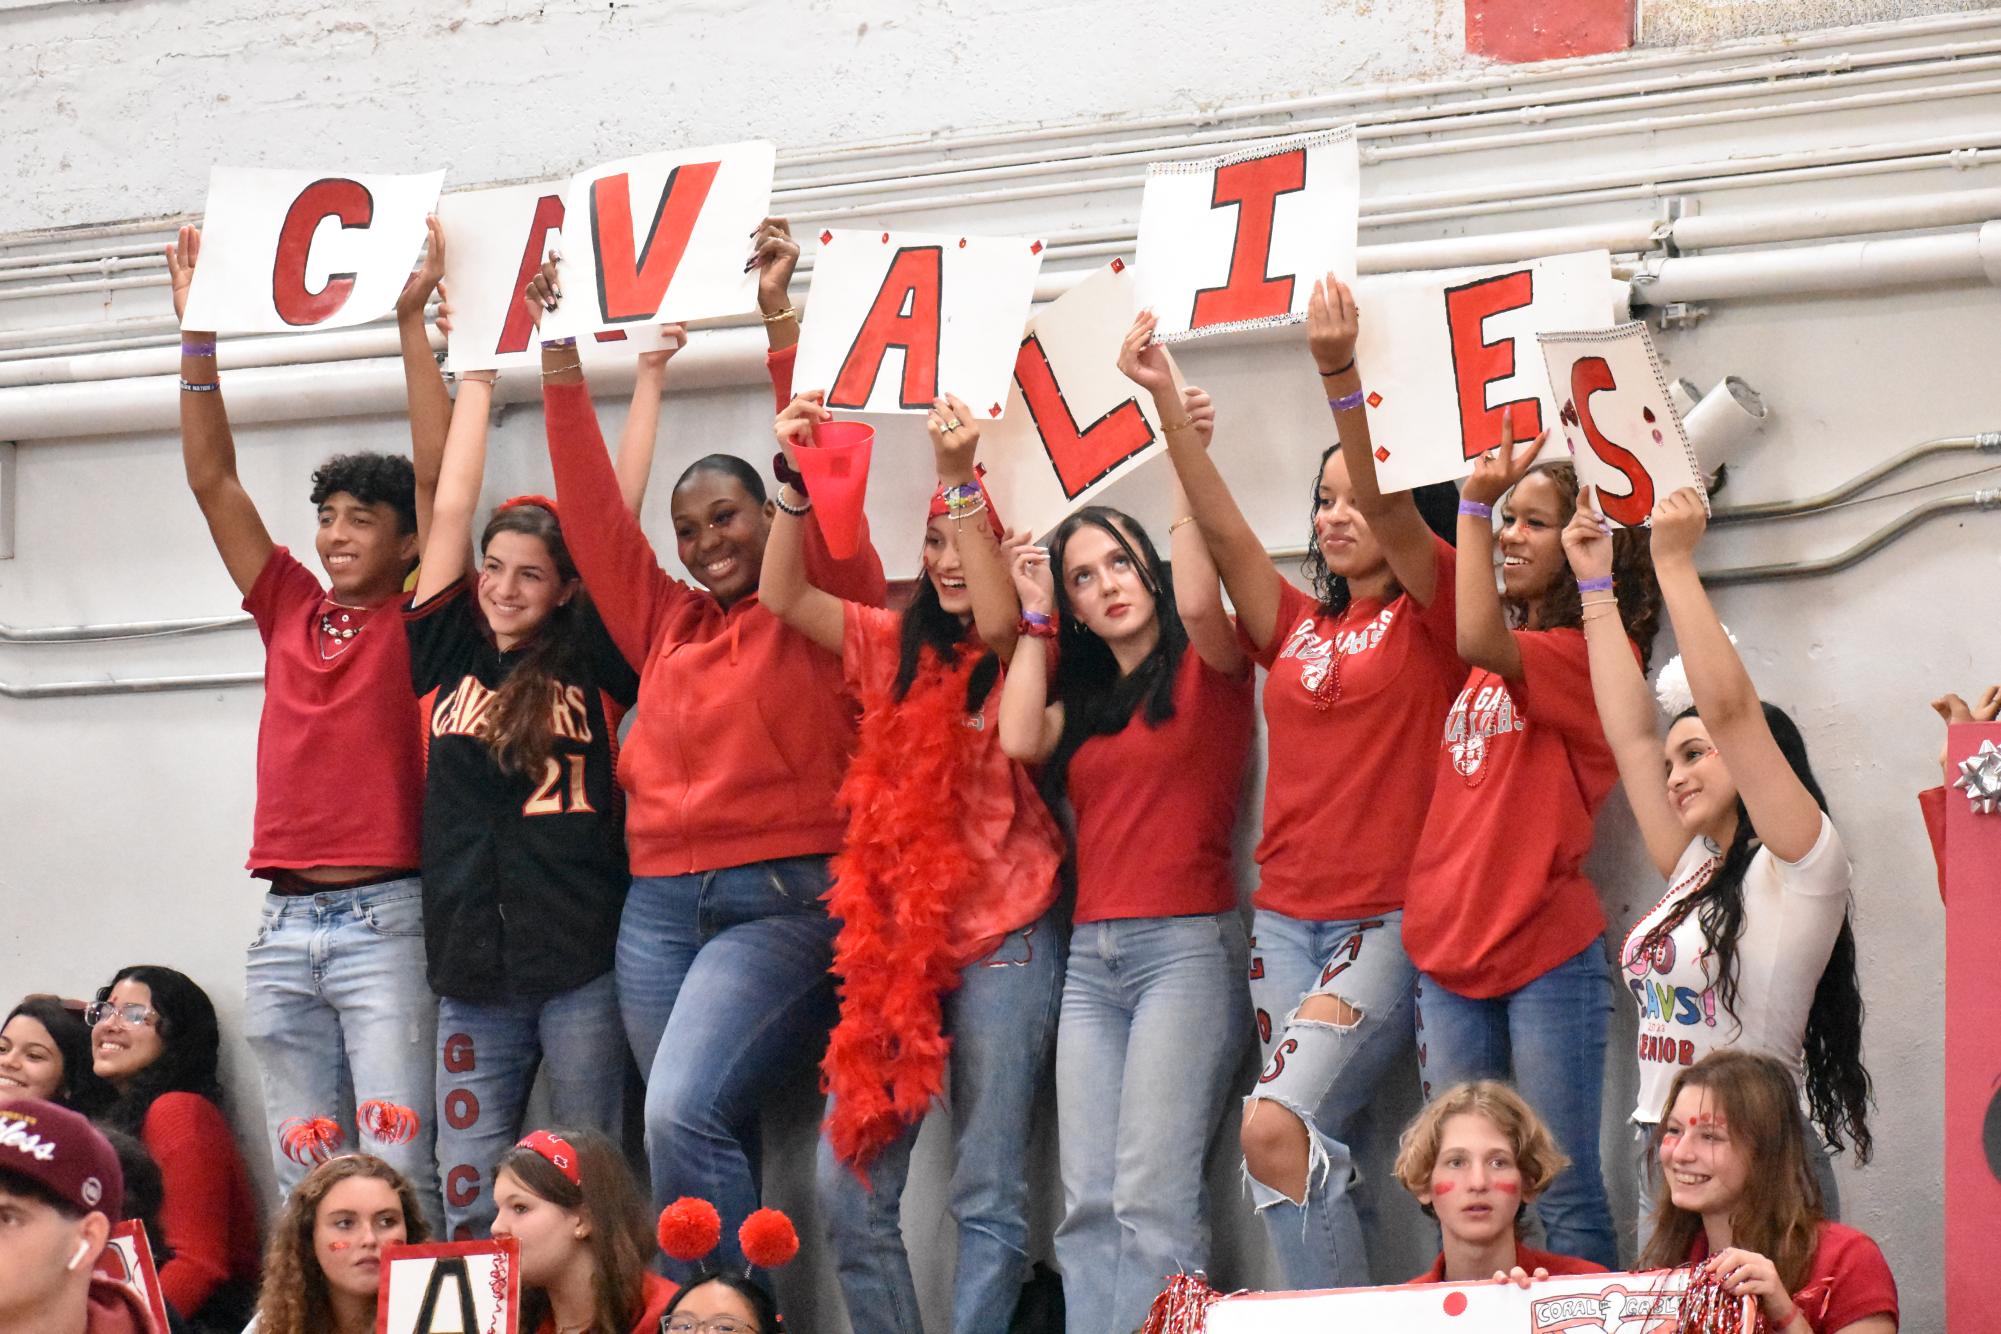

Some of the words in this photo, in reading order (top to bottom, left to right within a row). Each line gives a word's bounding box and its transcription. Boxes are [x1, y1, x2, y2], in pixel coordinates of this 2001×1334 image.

[273, 178, 374, 325] C
[590, 160, 721, 324] V
[826, 245, 943, 410] A
[1013, 330, 1156, 500] L
[1191, 147, 1307, 330] I
[1444, 269, 1543, 462] E
[1571, 356, 1655, 527] S
[522, 753, 597, 817] 21
[1625, 935, 1676, 976] GO
[1639, 1033, 1695, 1066] ENIOR
[411, 1256, 481, 1334] A
[1537, 1299, 1597, 1323] CORAL
